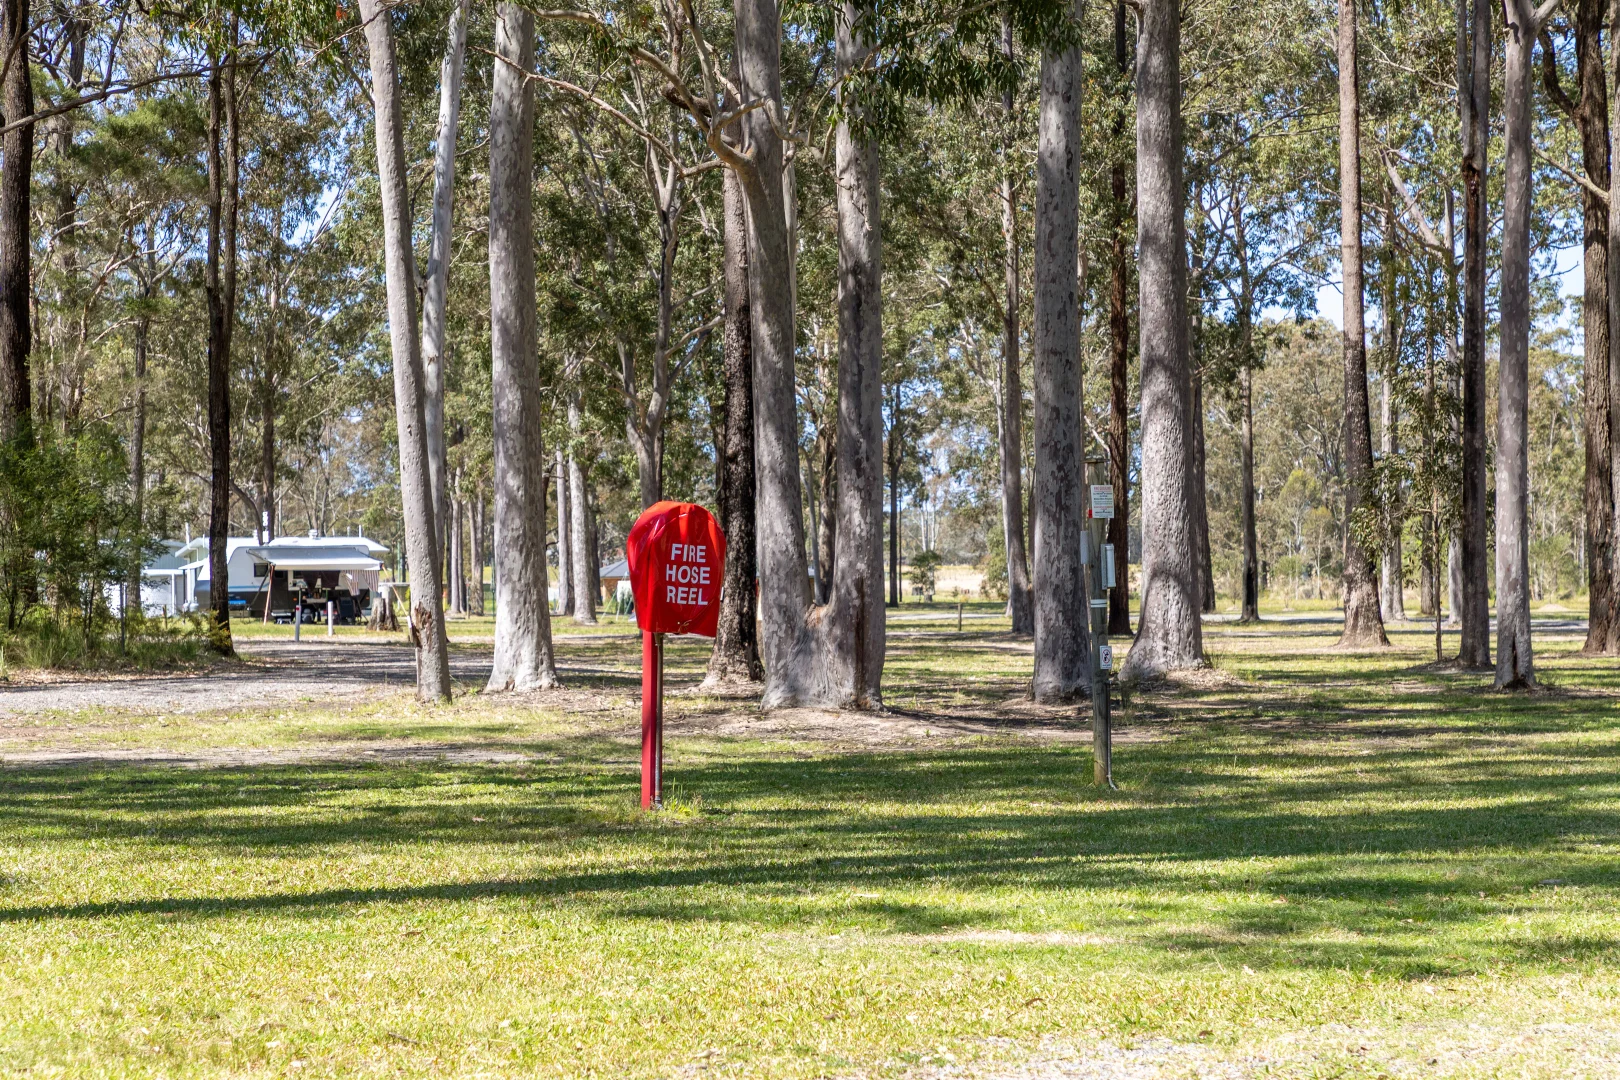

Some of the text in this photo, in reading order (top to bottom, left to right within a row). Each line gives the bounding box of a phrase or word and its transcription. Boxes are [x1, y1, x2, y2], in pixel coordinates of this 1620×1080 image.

[671, 543, 706, 563] FIRE
[666, 564, 710, 584] HOSE
[666, 585, 708, 605] REEL
